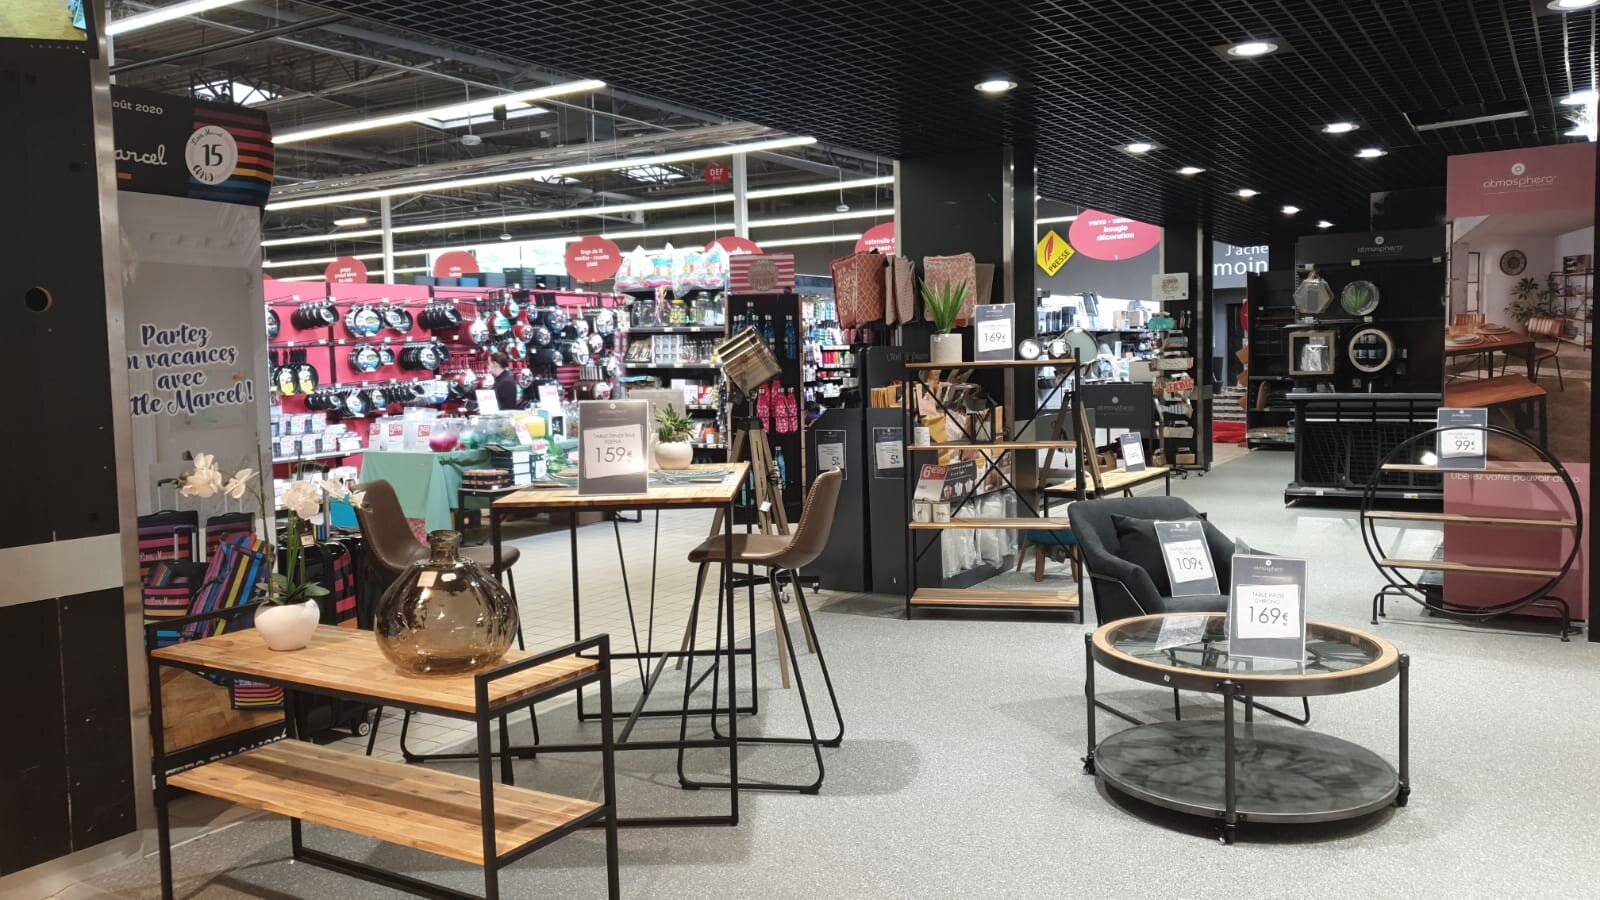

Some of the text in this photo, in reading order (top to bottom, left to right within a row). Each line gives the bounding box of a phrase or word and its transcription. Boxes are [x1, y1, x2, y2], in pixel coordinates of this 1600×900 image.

[135, 103, 164, 115] 2020
[201, 144, 223, 167] 15
[1096, 232, 1135, 241] décoration
[1103, 224, 1129, 233] bougie
[1048, 248, 1071, 272] PRESSE
[141, 324, 208, 348] Partez
[145, 347, 236, 369] vacances
[157, 371, 204, 390] avec
